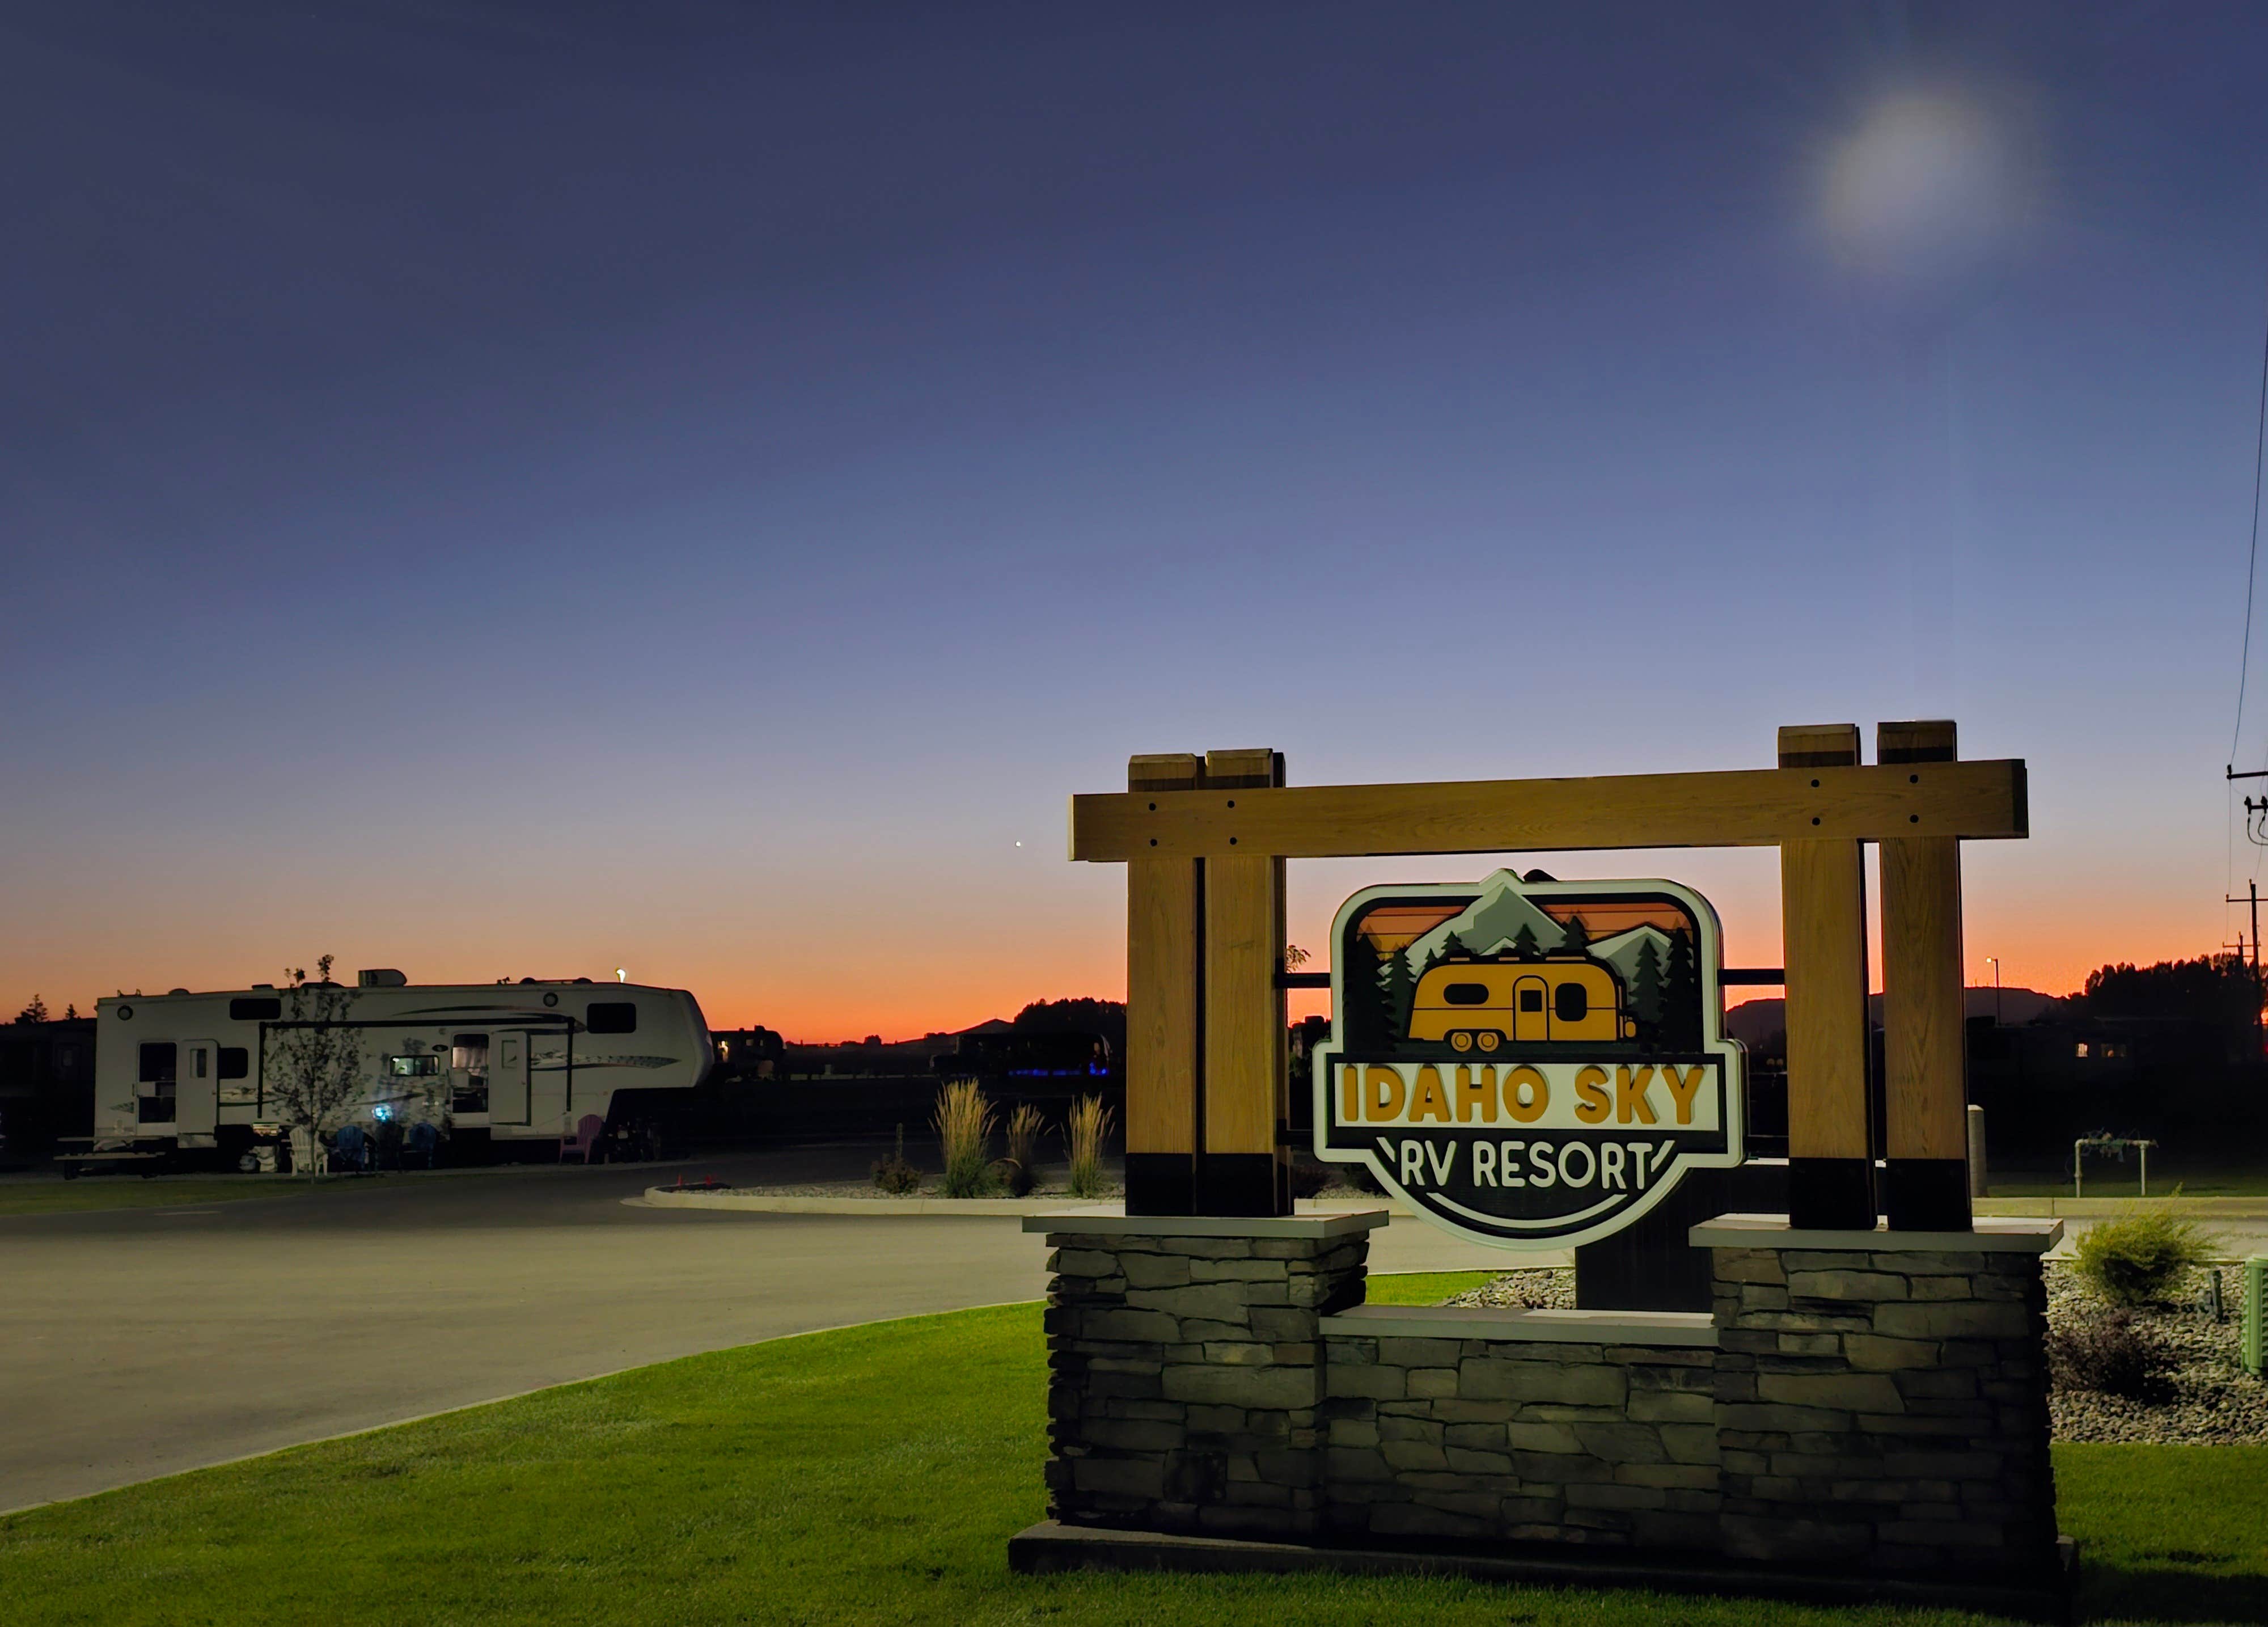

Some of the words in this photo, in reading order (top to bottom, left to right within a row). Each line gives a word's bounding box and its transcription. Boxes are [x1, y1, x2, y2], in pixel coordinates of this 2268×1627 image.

[1343, 1064, 1549, 1123] IDAHO
[1574, 1065, 1704, 1125] SKY
[1400, 1139, 1457, 1187] RV
[1473, 1139, 1653, 1190] RESORT
